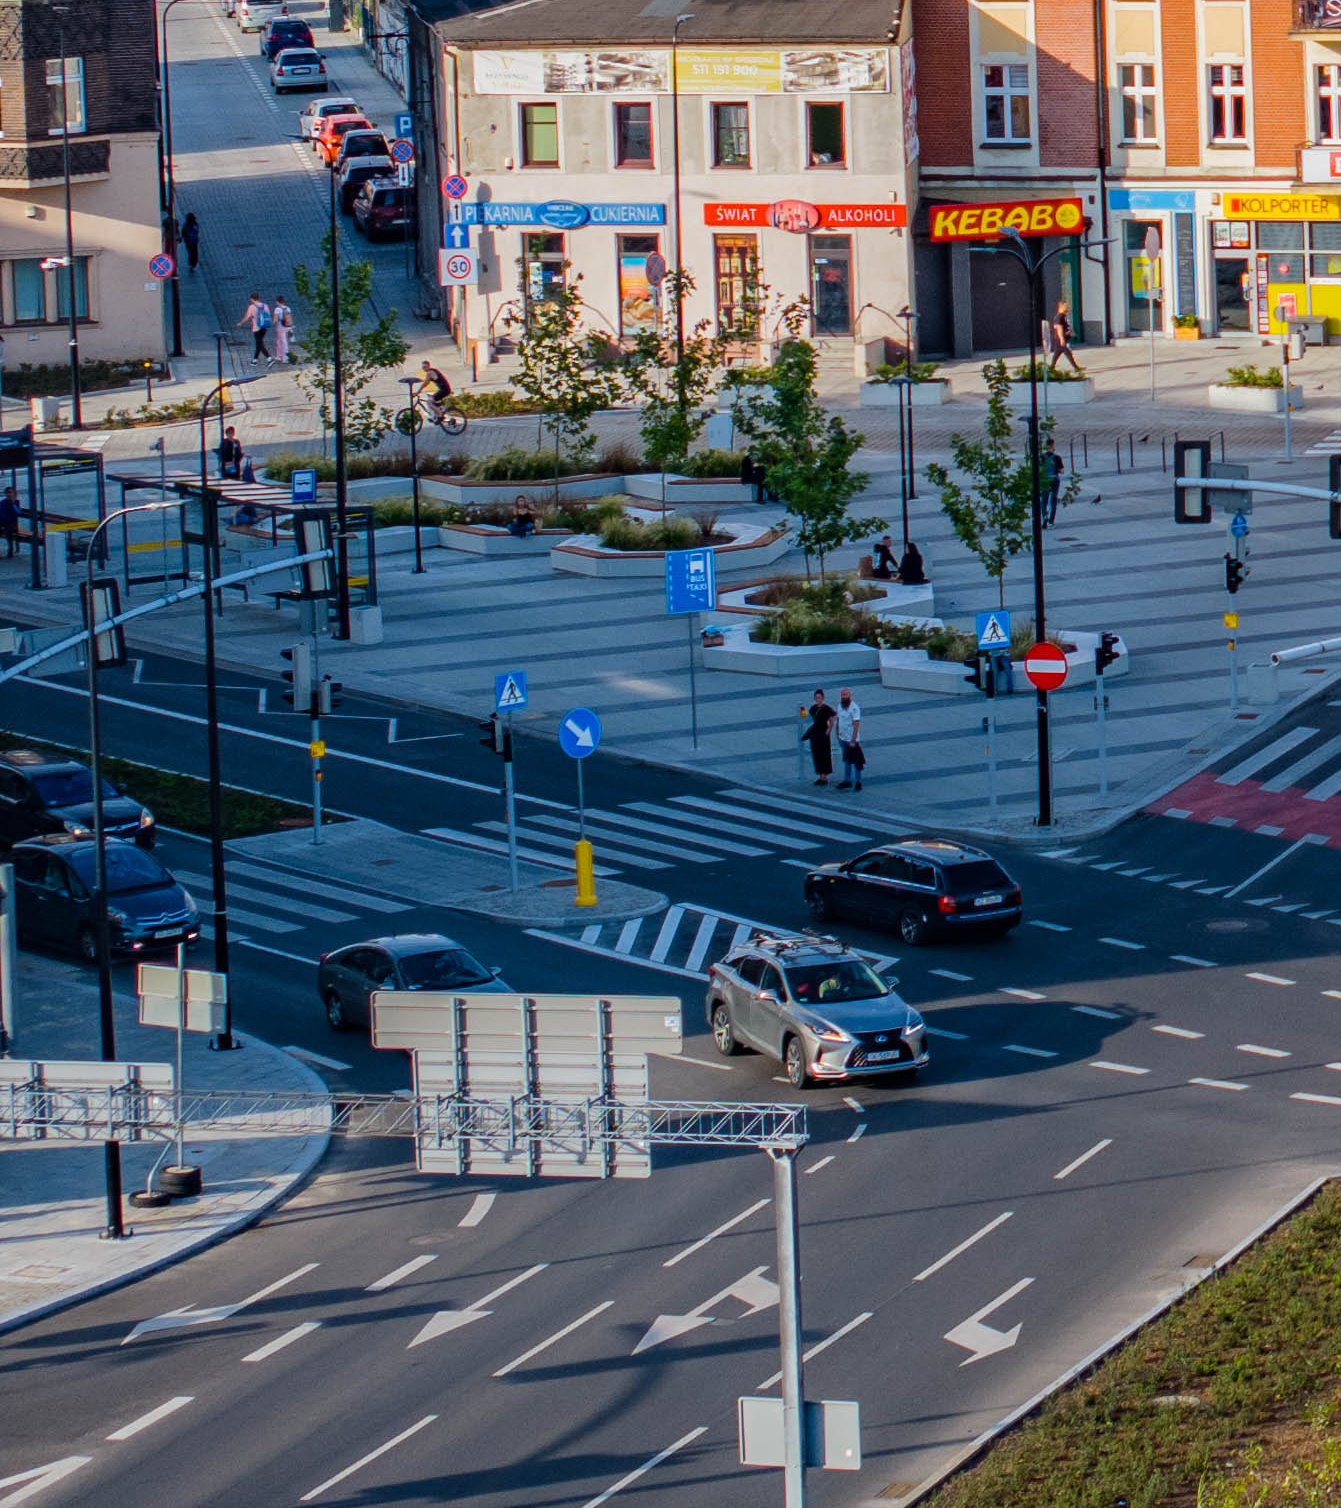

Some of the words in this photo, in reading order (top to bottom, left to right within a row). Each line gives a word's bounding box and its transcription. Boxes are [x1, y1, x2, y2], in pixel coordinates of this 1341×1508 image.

[400, 117, 412, 134] P
[1240, 198, 1329, 213] KOLPORTER
[465, 206, 535, 222] PIEKARNIA
[590, 206, 661, 222] CUKIERNIA
[716, 206, 758, 221] ŚWIAT
[828, 208, 896, 222] ALKOHOLI
[933, 204, 1054, 237] KEBAB
[450, 261, 468, 273] 30
[690, 574, 705, 583] BUS
[690, 583, 707, 591] TAXI
